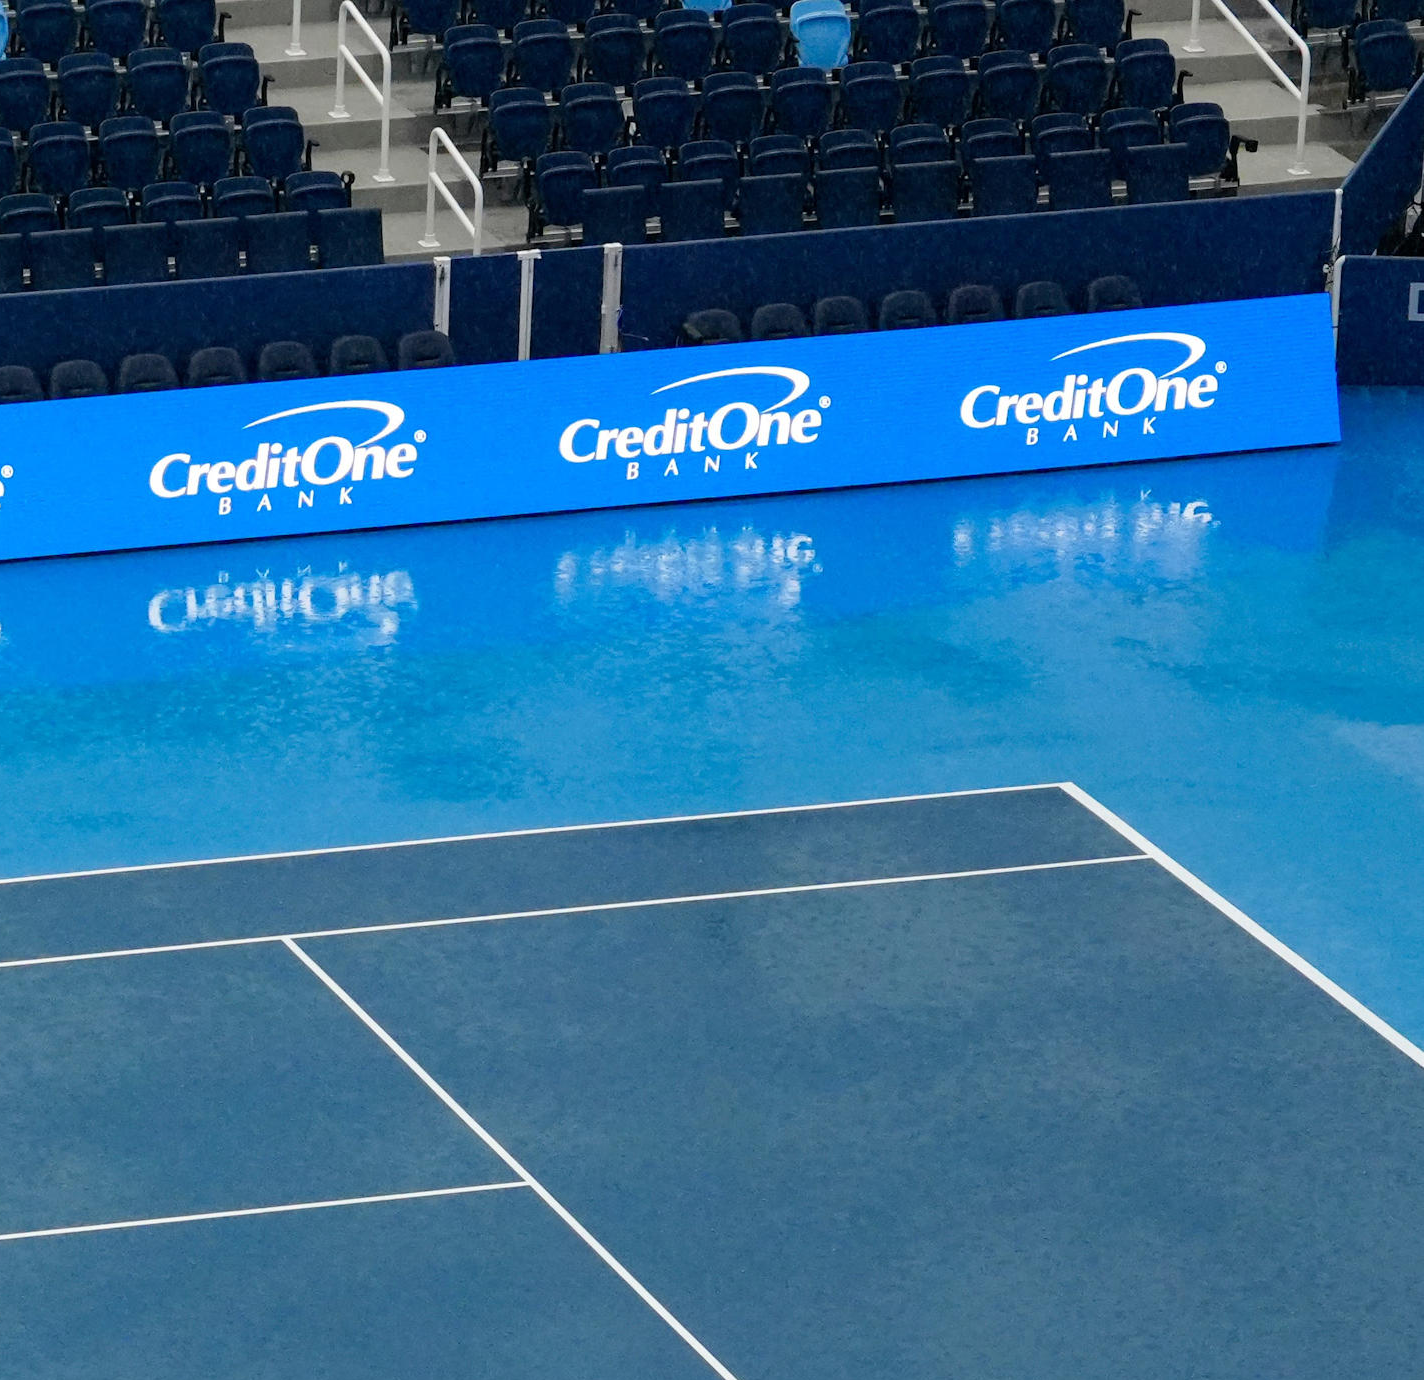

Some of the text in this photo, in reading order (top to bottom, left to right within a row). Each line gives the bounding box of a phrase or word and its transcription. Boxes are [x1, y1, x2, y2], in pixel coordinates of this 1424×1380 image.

[960, 366, 1217, 430] CreditOne
[559, 400, 821, 464] CreditOne
[1027, 417, 1157, 447] BANK
[149, 435, 418, 500] CreditOne
[626, 451, 758, 481] BANK
[219, 486, 353, 516] BANK
